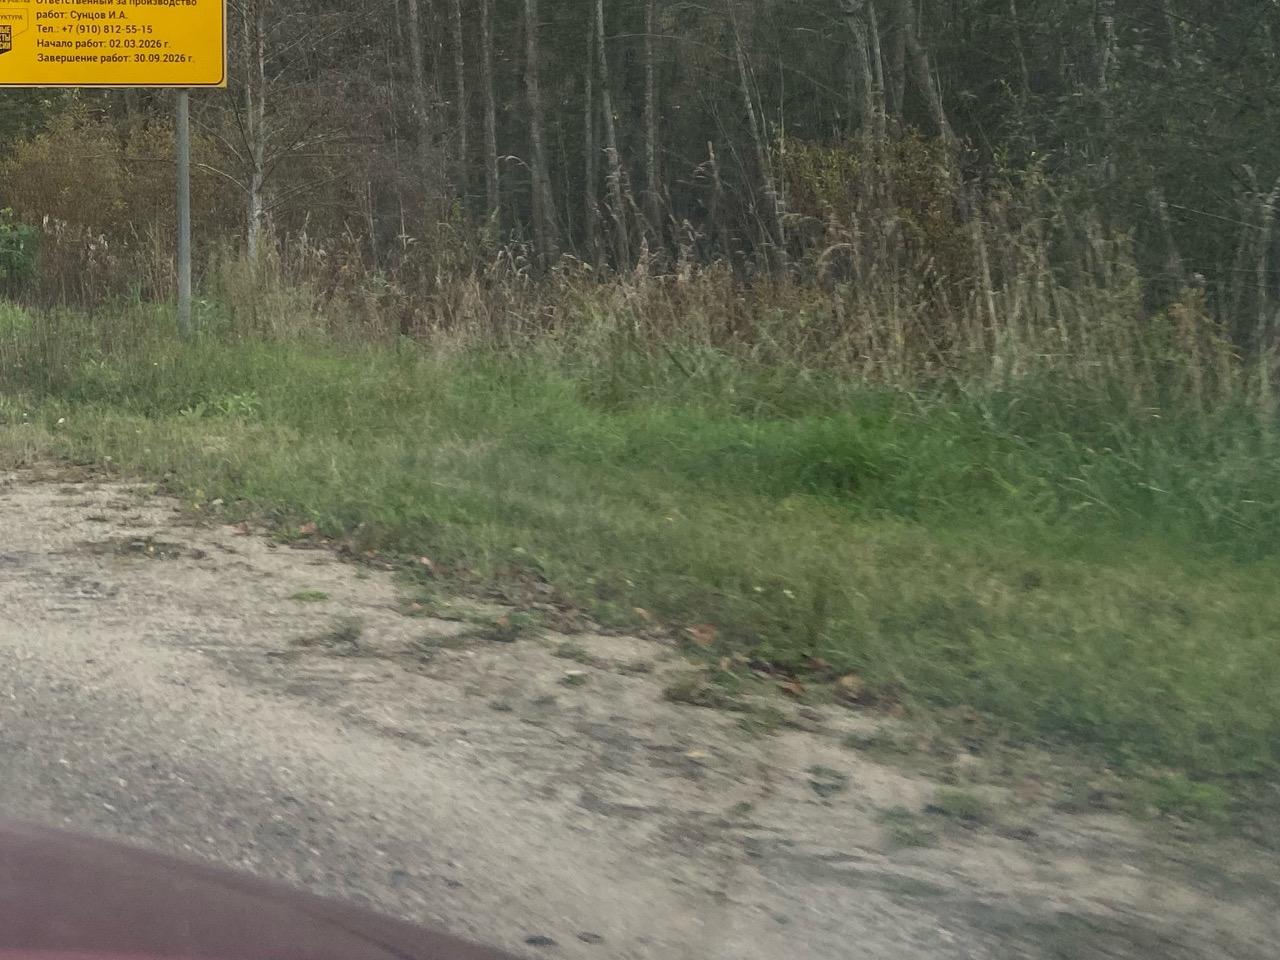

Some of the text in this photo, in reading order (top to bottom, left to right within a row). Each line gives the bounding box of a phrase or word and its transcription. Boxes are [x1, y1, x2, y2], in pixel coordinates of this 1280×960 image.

[36, 10, 128, 21] работ: Сунцов И.А.
[62, 25, 74, 33] +7
[76, 24, 101, 35] (910)
[103, 25, 153, 34] 812-55-15
[37, 39, 73, 48] Начало
[75, 39, 107, 50] работ:
[109, 39, 162, 49] 02.03.2026
[37, 53, 98, 64] Завершение
[100, 53, 132, 64] работ:
[134, 54, 186, 63] 30.09.2026
